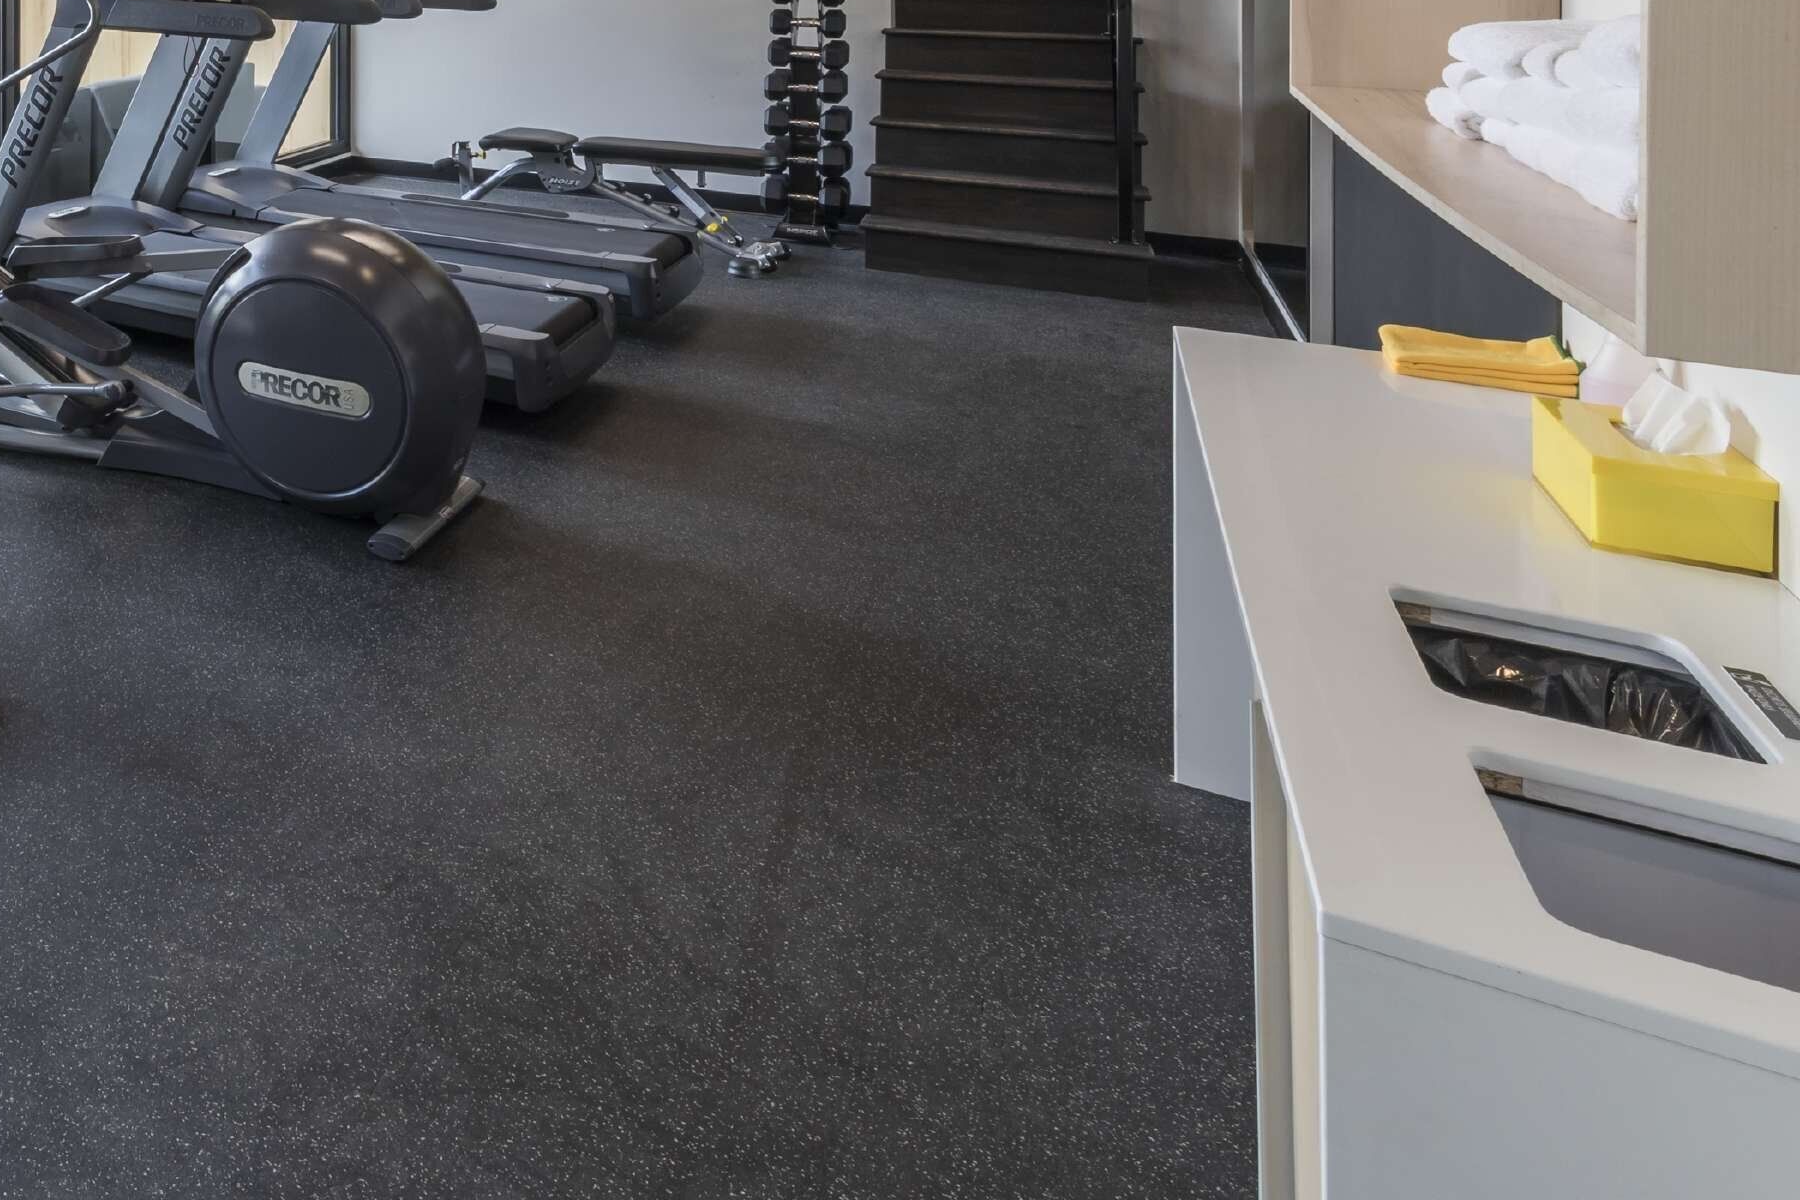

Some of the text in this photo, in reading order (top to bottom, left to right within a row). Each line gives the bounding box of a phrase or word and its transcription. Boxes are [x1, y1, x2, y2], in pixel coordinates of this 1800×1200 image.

[196, 13, 246, 33] PRECOR
[0, 64, 64, 189] PRECOR
[172, 45, 232, 151] PRECOR
[250, 369, 354, 410] PRECOR USA
